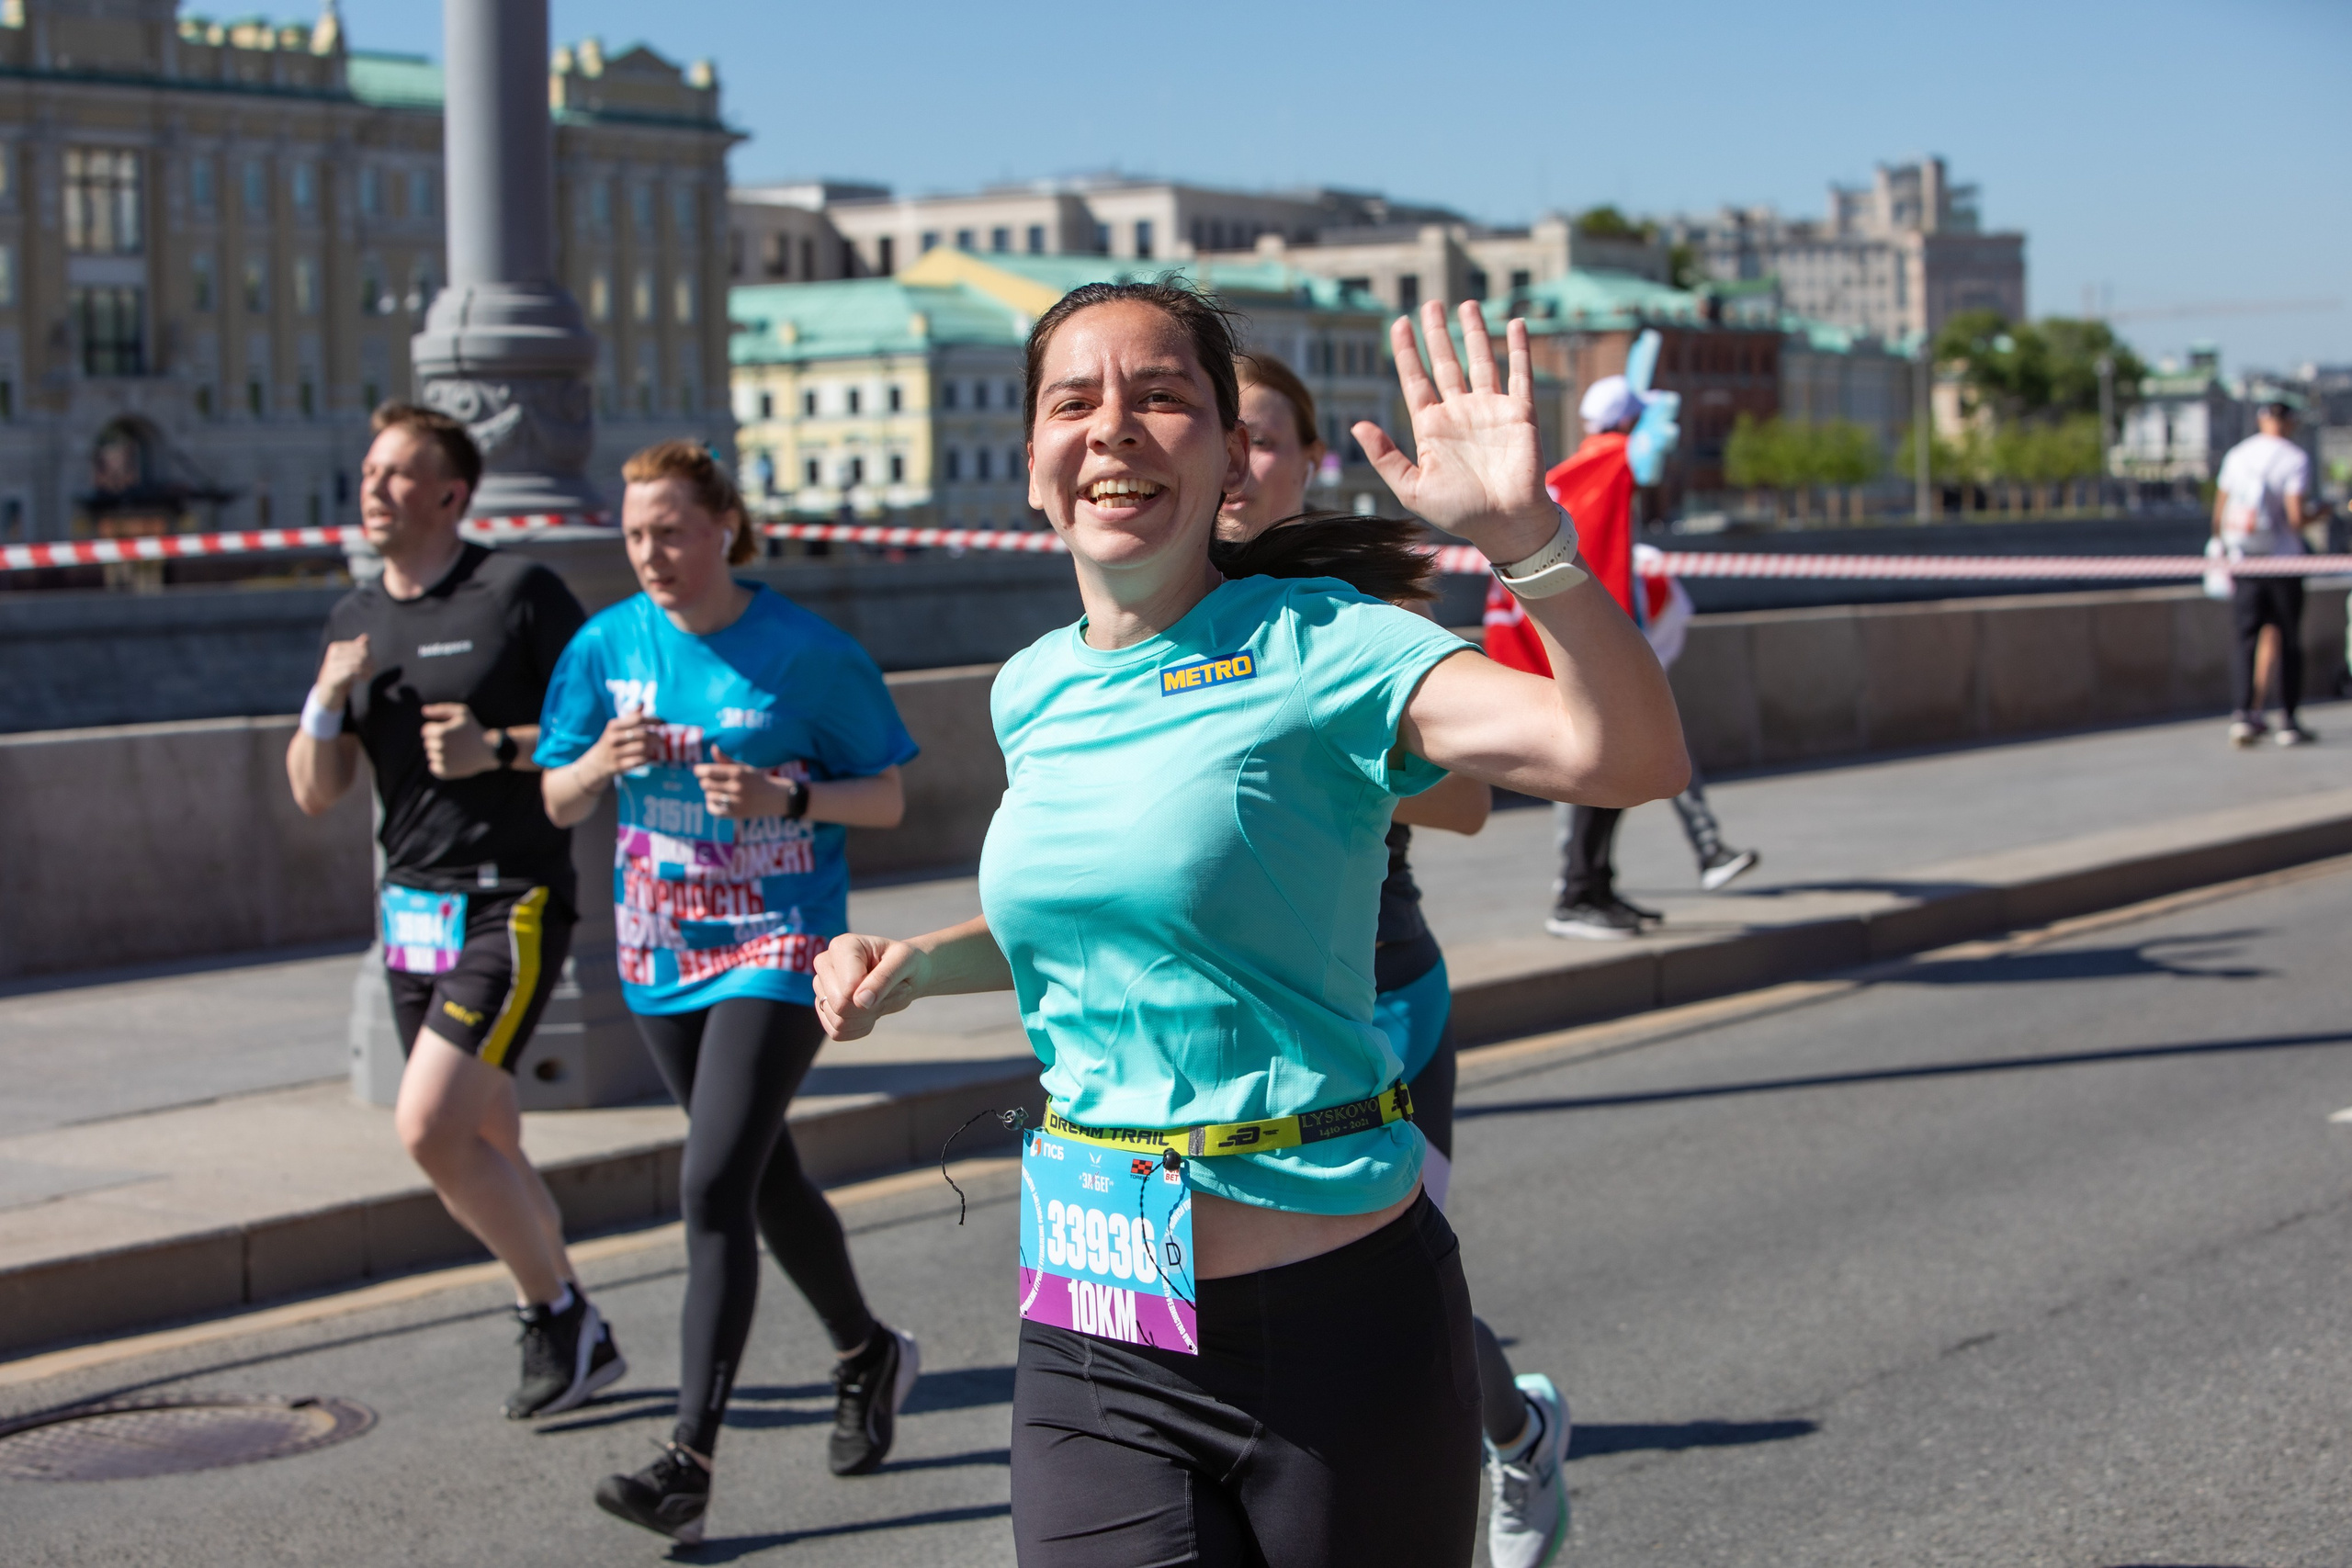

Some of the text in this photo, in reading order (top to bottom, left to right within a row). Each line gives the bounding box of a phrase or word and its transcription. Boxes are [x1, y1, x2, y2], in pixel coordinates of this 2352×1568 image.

[1163, 655, 1252, 692] METRO
[1301, 1099, 1378, 1129] LYSKOVO
[1319, 1126, 1340, 1138] 1410
[1350, 1118, 1370, 1131] 2021
[1049, 1113, 1170, 1147] DREAM TRAIL
[1043, 1143, 1065, 1161] ПСБ
[1165, 1172, 1180, 1182] BET
[1046, 1199, 1159, 1284] 33936
[1166, 1241, 1182, 1268] D
